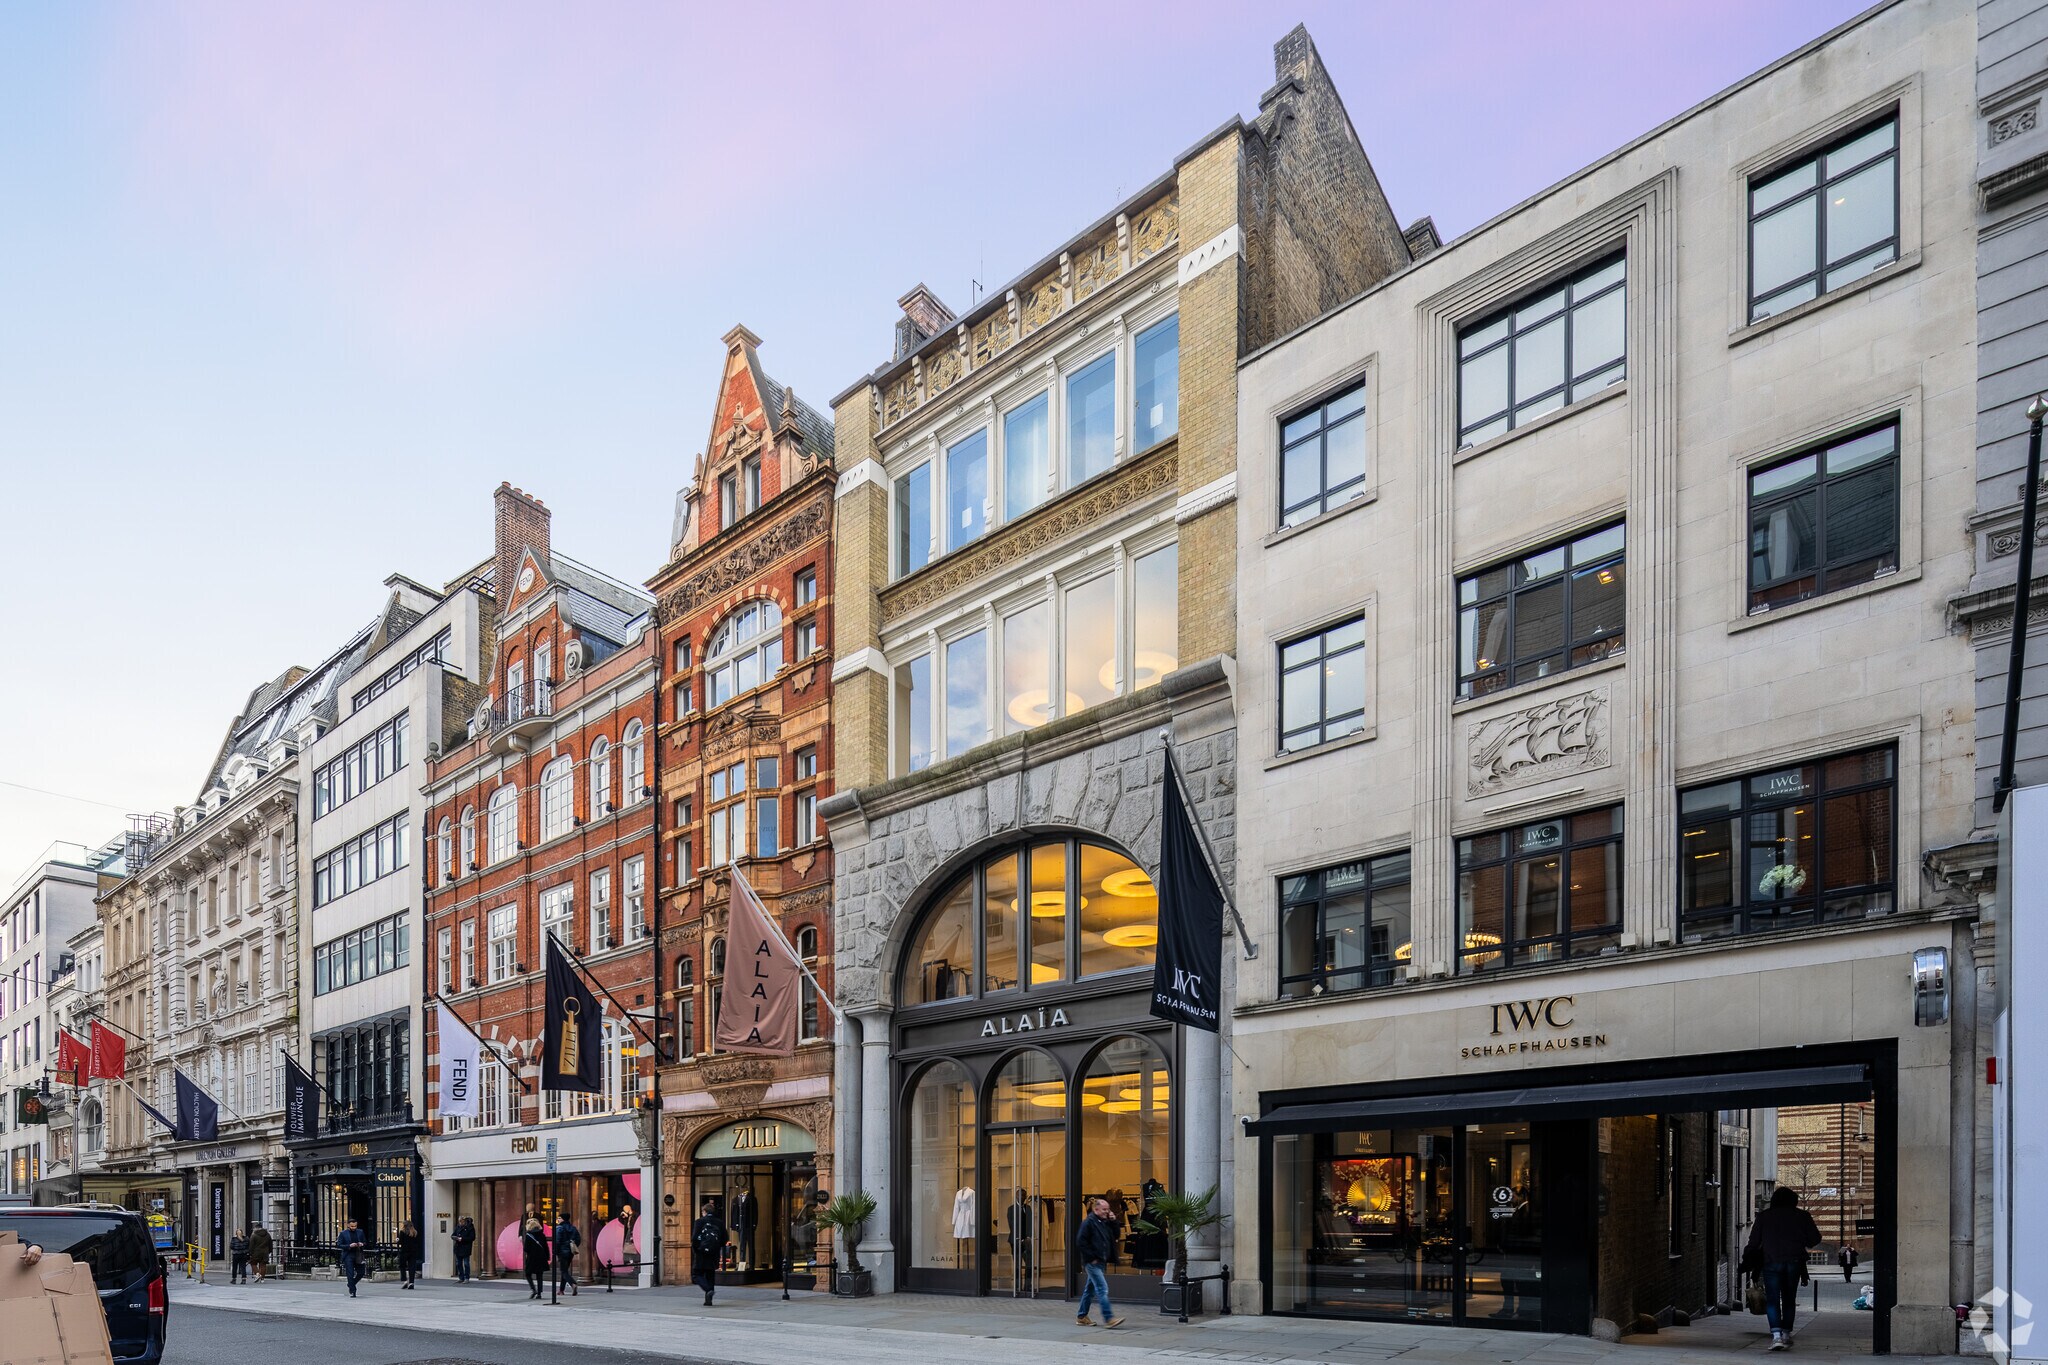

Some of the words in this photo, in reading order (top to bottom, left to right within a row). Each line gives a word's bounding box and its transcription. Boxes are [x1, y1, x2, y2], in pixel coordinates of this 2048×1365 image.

[1760, 784, 1810, 797] SCHAFFHAUSEN
[1770, 774, 1799, 789] IWC
[1519, 837, 1559, 848] SCHAFFHAUSEN
[1528, 828, 1550, 840] IWC
[1337, 870, 1355, 881] IWC
[981, 1006, 1069, 1037] ALAÏA
[1490, 996, 1575, 1036] IWC
[563, 1029, 577, 1068] ZILLI
[1461, 1034, 1608, 1059] SCHAFFHAUSEN
[452, 1059, 467, 1101] FENDI
[296, 1086, 304, 1131] MALINGUE
[511, 1136, 538, 1154] FENDI
[732, 1124, 780, 1150] ZILLI
[377, 1172, 405, 1182] Chloé
[1498, 1189, 1507, 1200] 6
